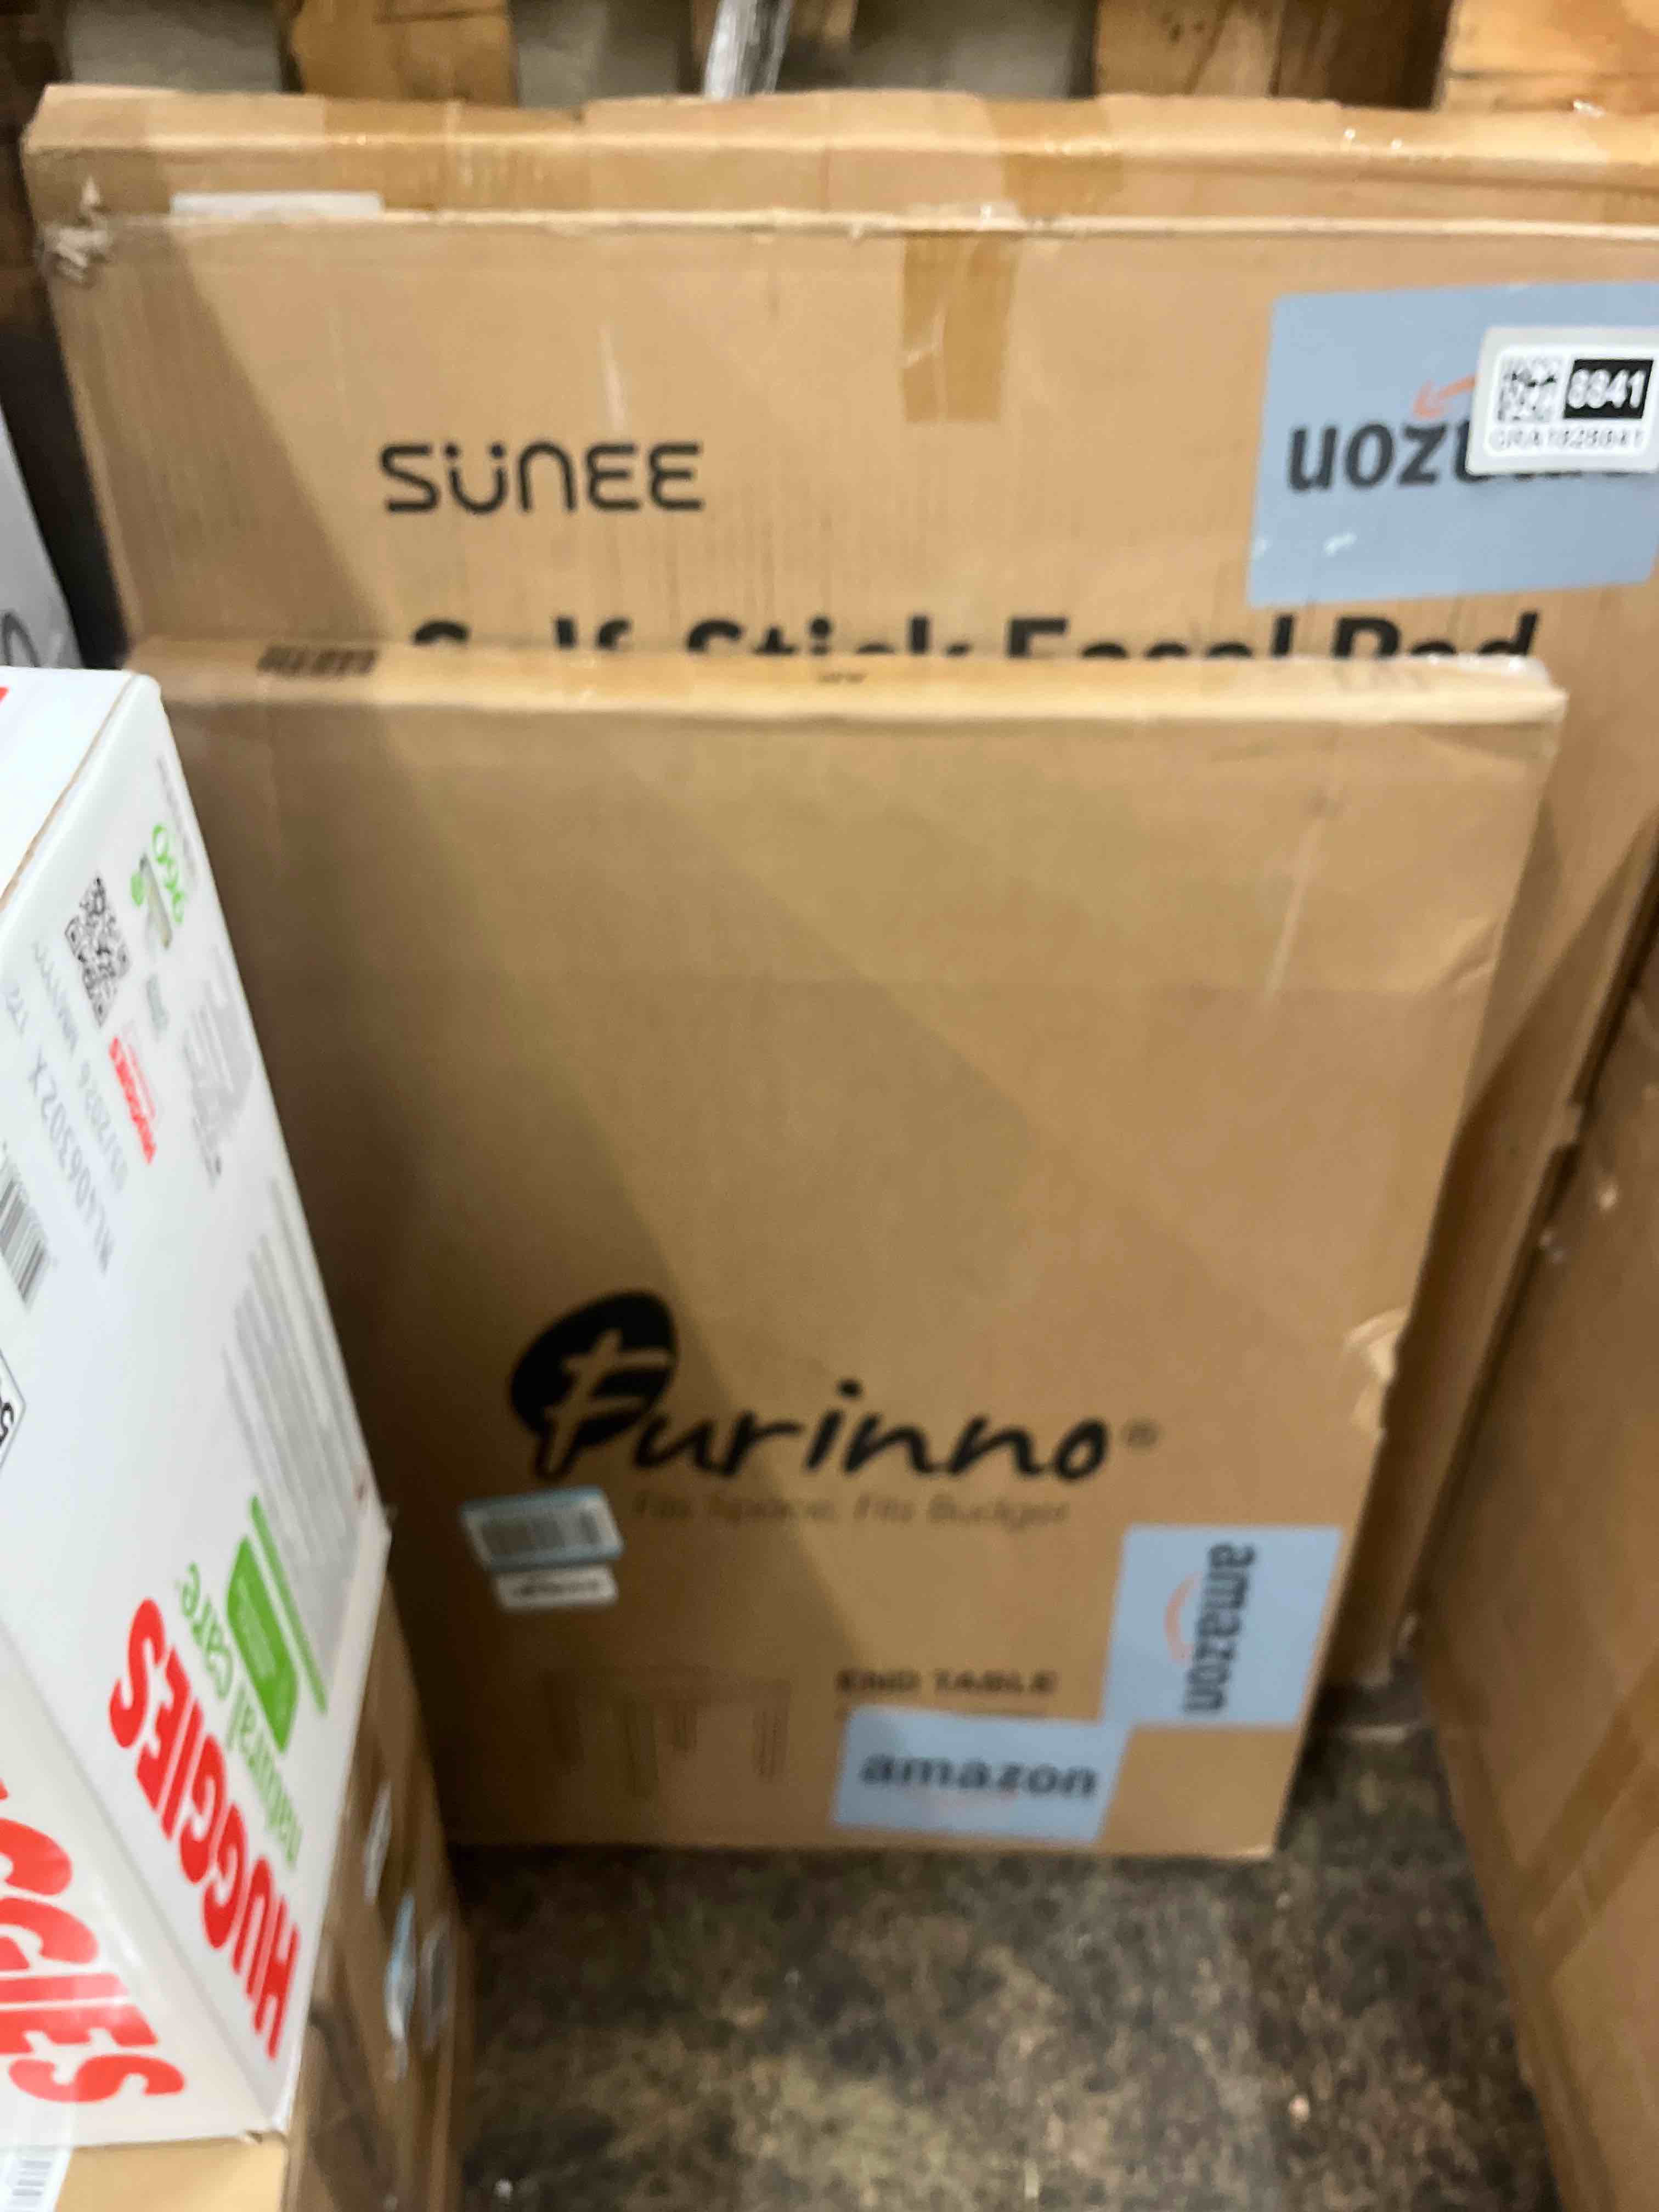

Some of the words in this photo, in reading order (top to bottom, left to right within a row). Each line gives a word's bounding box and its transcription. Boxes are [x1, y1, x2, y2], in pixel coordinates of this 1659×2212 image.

[510, 1290, 1109, 1482] Furinno
[833, 1667, 922, 1693] END
[933, 1668, 1059, 1695] TABLE
[1182, 1543, 1256, 1714] amazon
[109, 1598, 300, 2060] HUGGIES
[859, 1753, 1098, 1799] amazon
